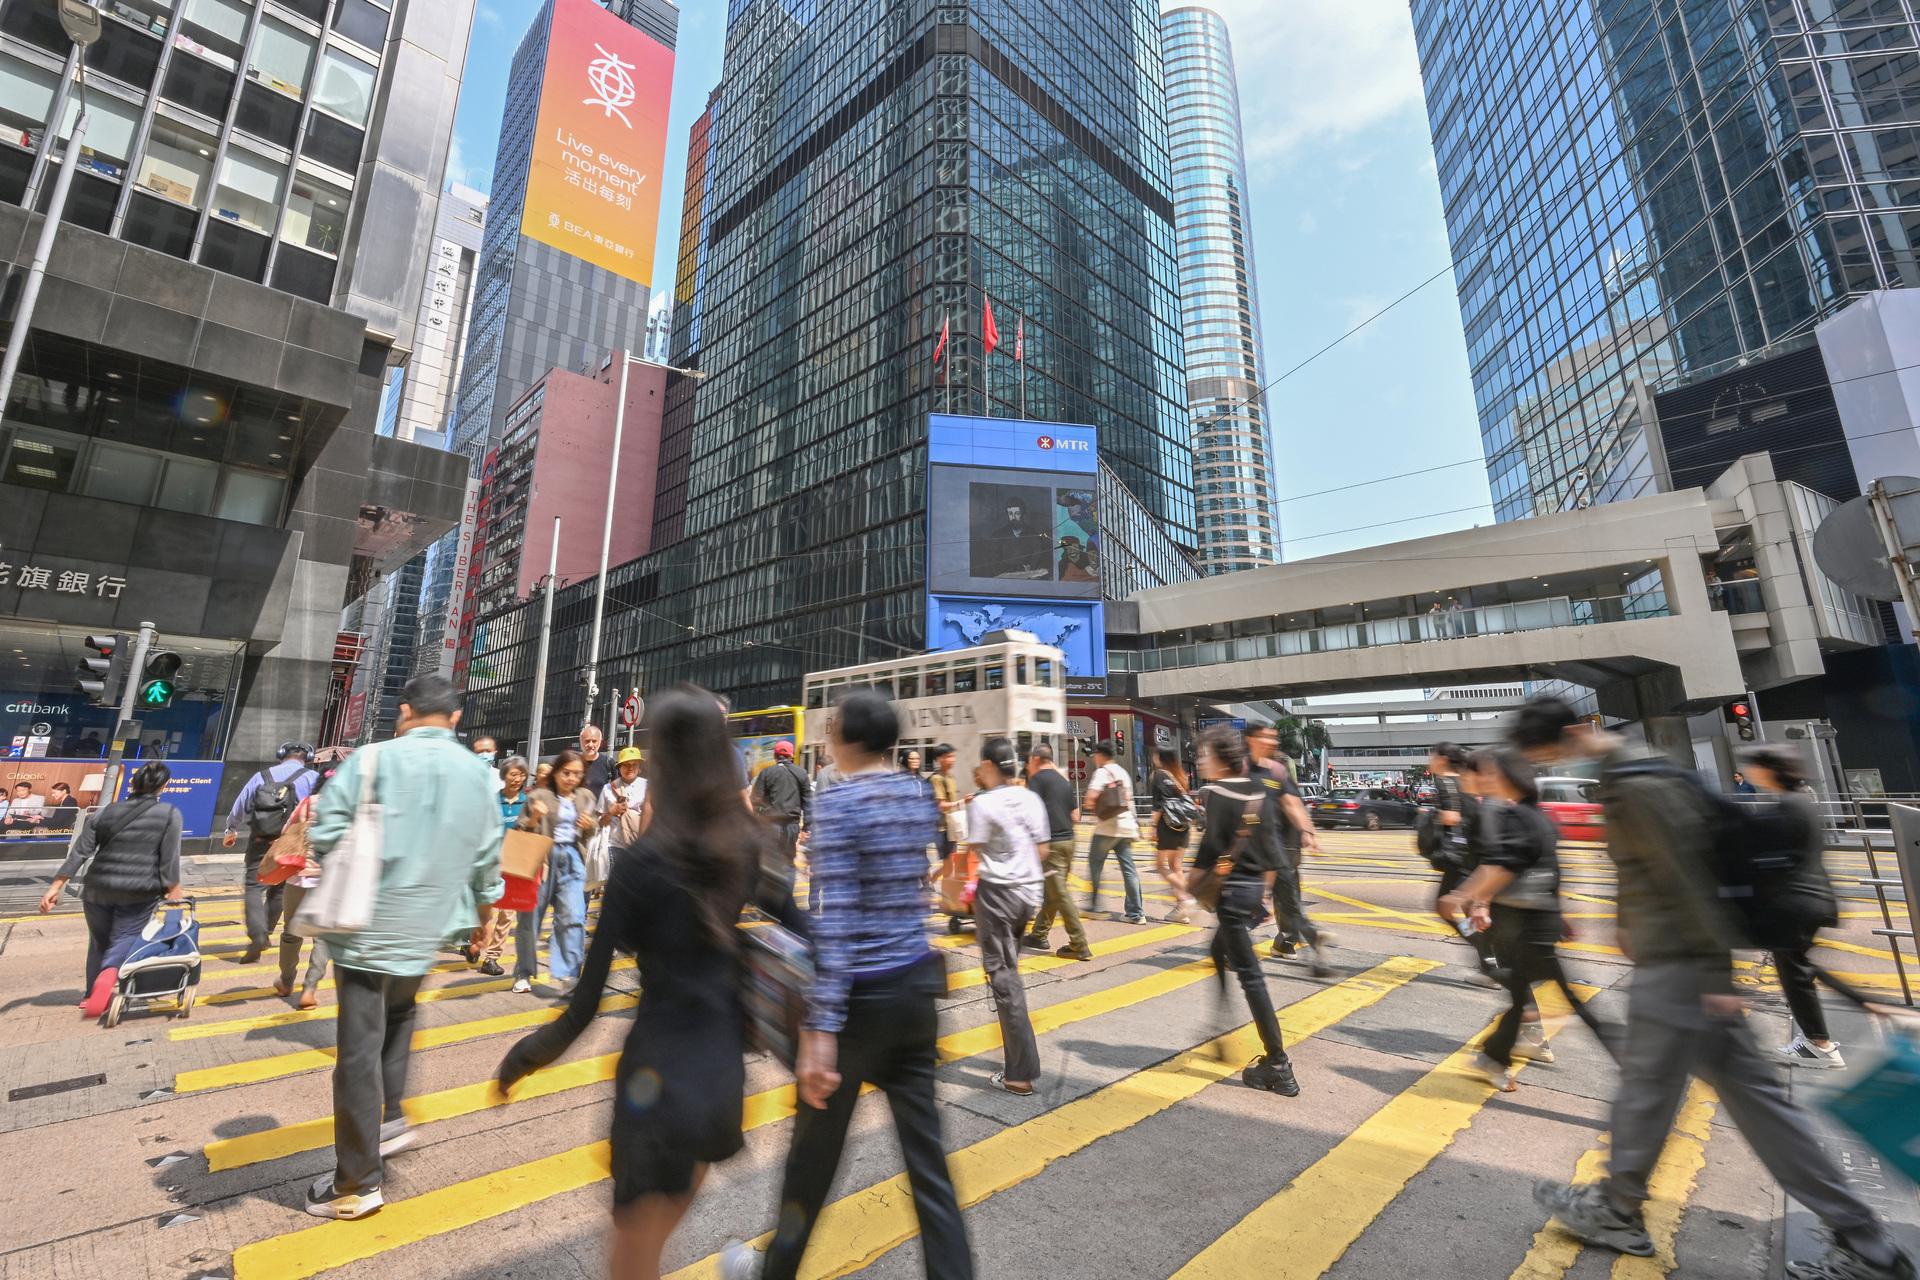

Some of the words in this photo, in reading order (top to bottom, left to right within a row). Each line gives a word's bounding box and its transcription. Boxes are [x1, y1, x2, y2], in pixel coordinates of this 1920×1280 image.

[556, 127, 593, 157] Live
[598, 153, 646, 185] every
[562, 150, 638, 196] moment
[564, 166, 632, 211] 活出每刻
[564, 220, 593, 241] BEA
[594, 233, 634, 259] 東亞銀行
[1056, 439, 1089, 451] MTR
[464, 490, 478, 525] THE
[448, 531, 471, 630] SIBERIAN
[6, 701, 70, 715] citibank
[7, 772, 47, 781] Citigold
